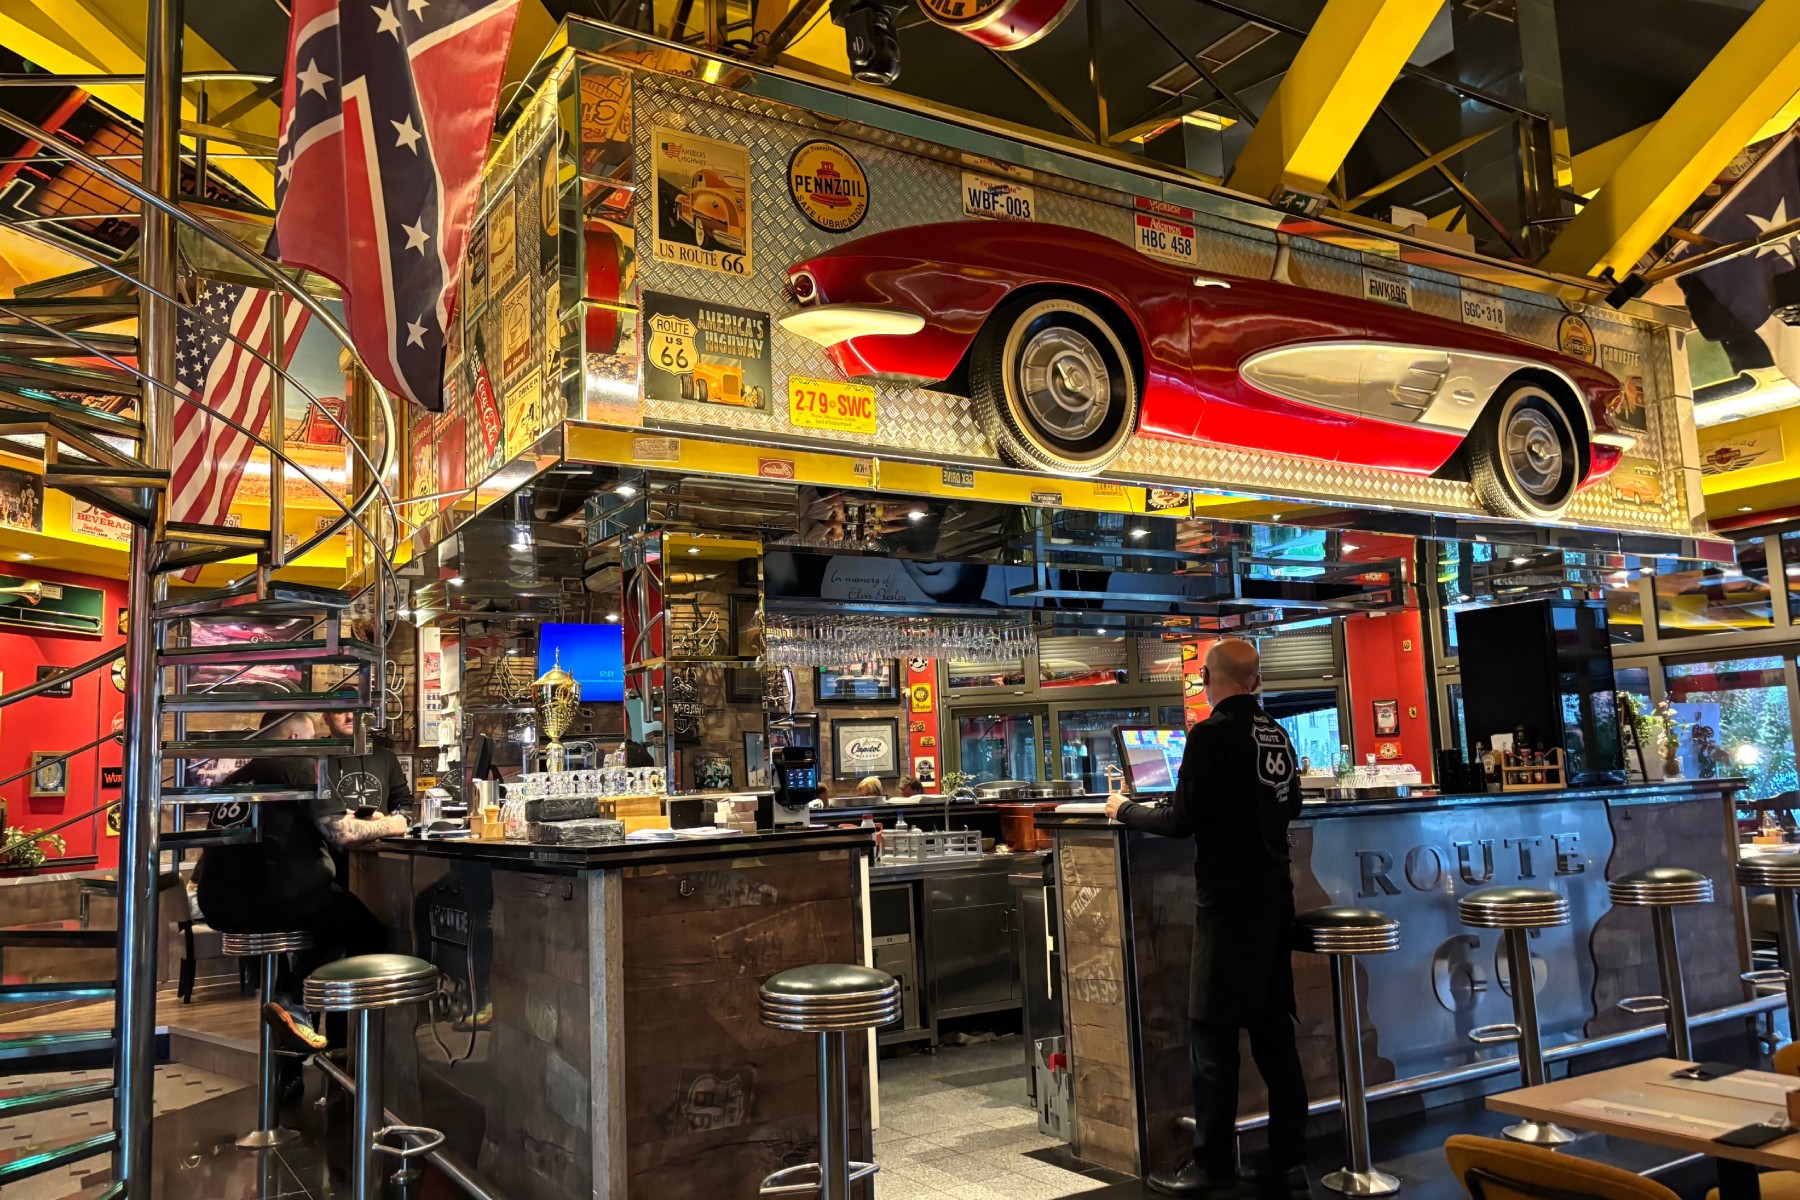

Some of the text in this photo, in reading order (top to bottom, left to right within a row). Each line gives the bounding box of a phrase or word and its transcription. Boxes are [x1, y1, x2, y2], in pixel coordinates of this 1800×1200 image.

[794, 174, 865, 198] PENNZOIL
[797, 194, 865, 229] SAFE LUBRICATION
[967, 186, 1031, 219] WBF-003
[1141, 227, 1166, 250] HBC
[1171, 235, 1192, 256] 458
[659, 242, 745, 274] US ROUTE 66
[656, 318, 690, 335] ROUTE
[697, 308, 764, 340] AMERICA'S
[665, 336, 683, 346] US
[704, 331, 764, 360] HIGHWAY
[661, 345, 689, 369] 66
[795, 389, 872, 419] 279 SWC
[77, 512, 130, 531] BEVERAG
[845, 575, 880, 588] memory
[850, 743, 882, 755] Capitol
[1259, 734, 1280, 743] ROUTE
[1265, 751, 1286, 776] 66
[217, 802, 241, 820] 66
[1355, 832, 1585, 899] ROUTE
